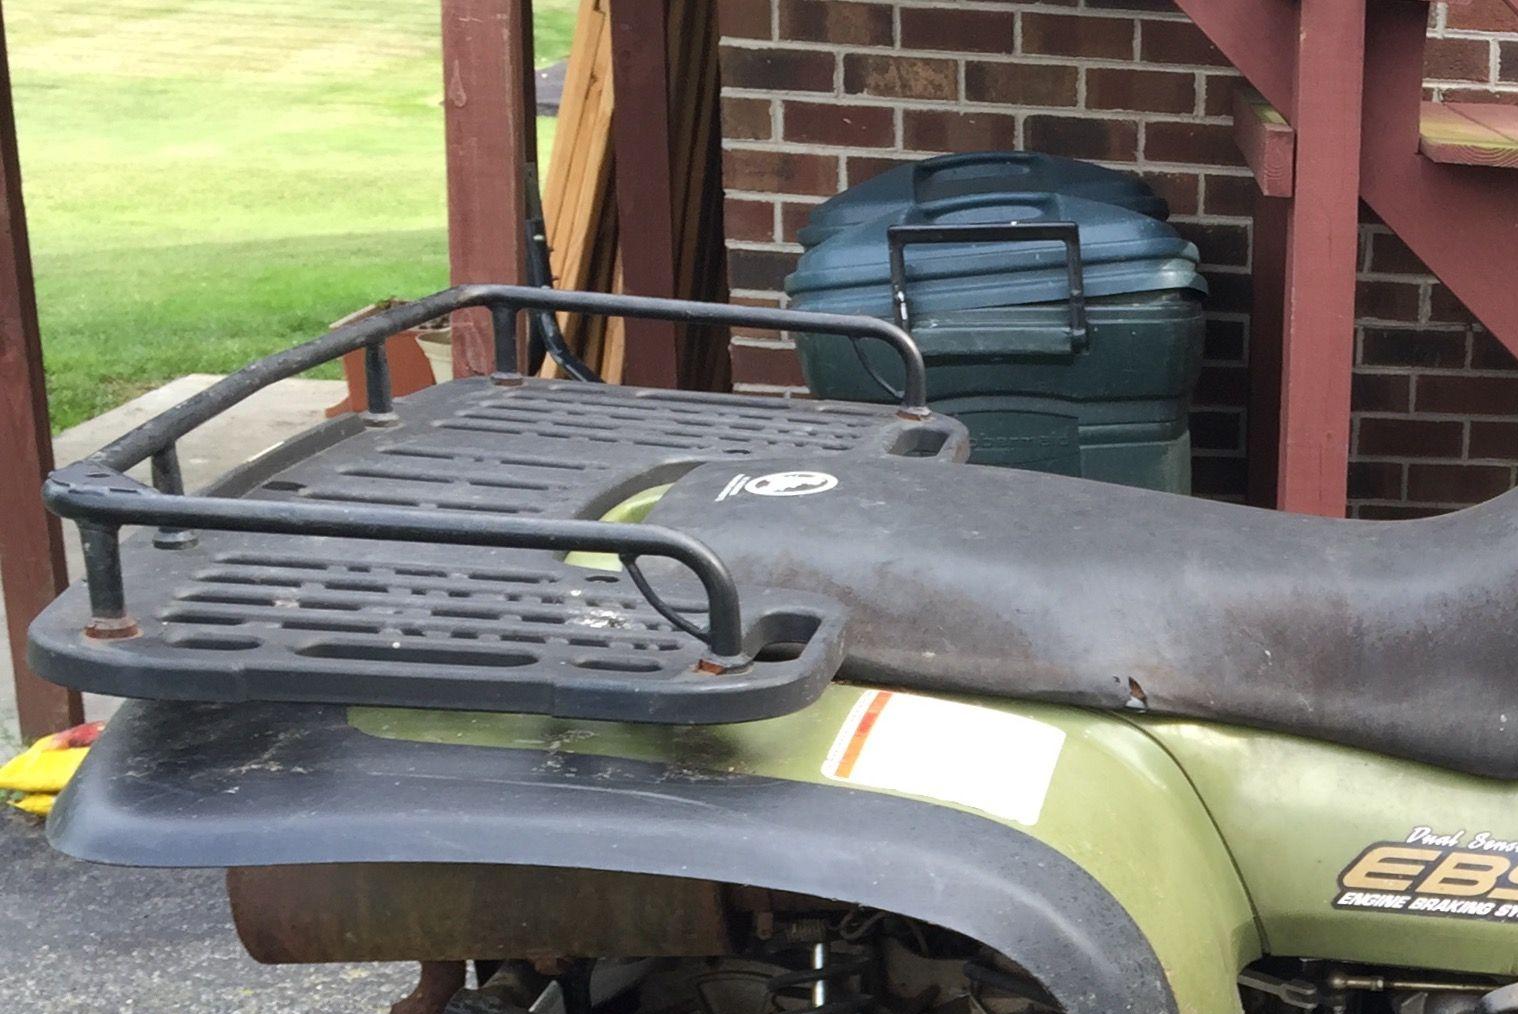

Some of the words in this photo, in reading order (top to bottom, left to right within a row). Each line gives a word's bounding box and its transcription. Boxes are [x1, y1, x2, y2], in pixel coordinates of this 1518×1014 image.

[1406, 826, 1465, 847] Dual
[1337, 891, 1410, 909] ENGINE
[1407, 896, 1493, 917] BRAKING
